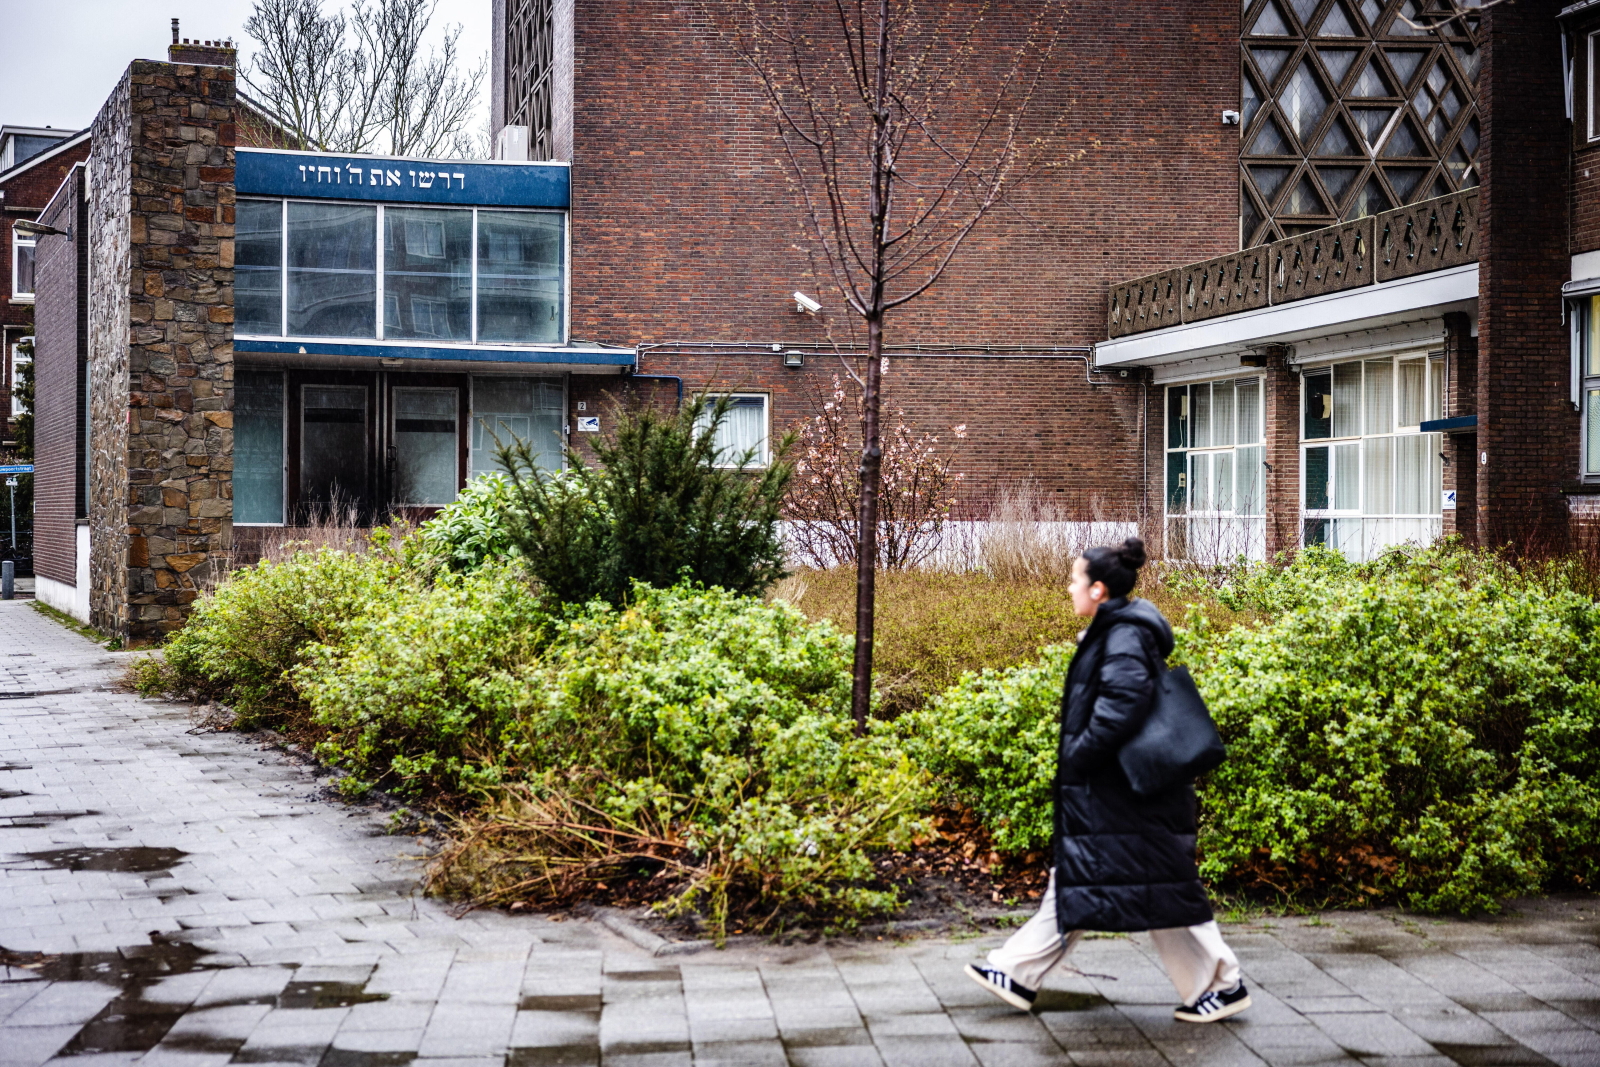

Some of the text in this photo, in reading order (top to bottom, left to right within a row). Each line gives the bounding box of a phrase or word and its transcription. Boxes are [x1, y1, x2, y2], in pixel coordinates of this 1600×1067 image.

[298, 164, 341, 185] וחיו
[369, 168, 402, 187] את
[408, 169, 466, 190] דרשו
